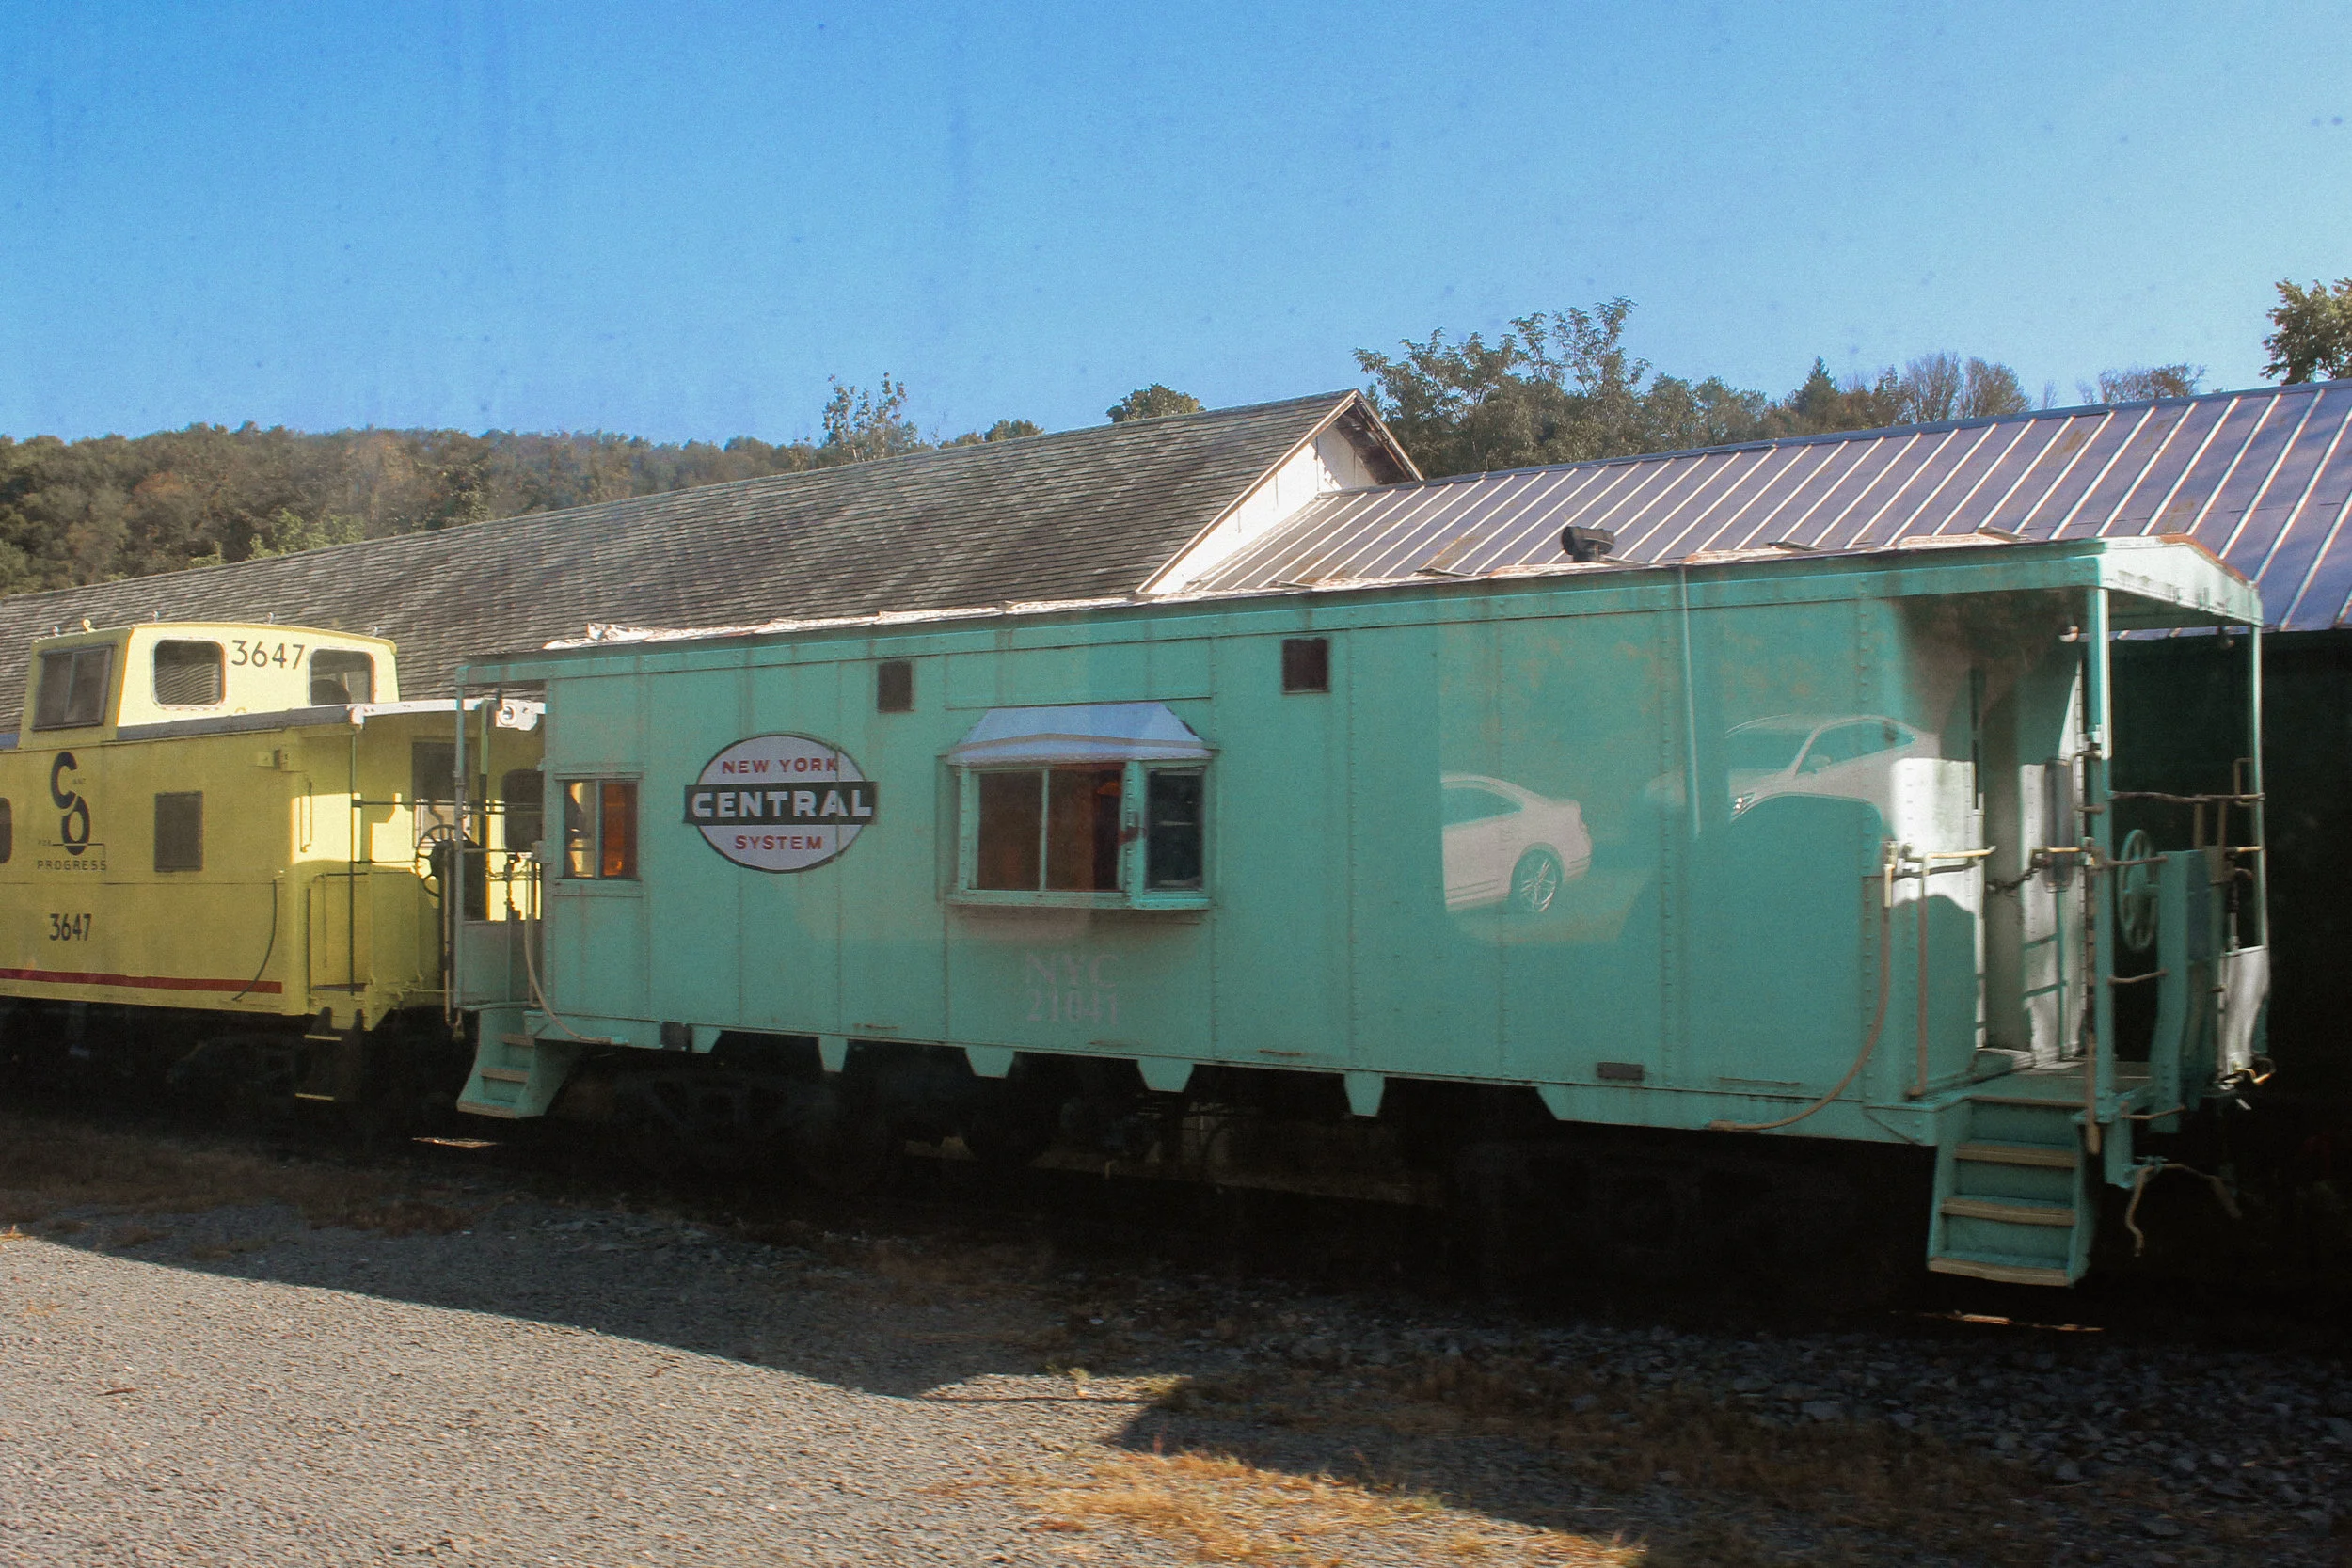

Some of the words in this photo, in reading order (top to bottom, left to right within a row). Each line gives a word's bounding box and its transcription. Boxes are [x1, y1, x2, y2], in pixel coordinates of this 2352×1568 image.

[231, 640, 305, 669] 3647
[722, 760, 770, 774] NEW
[779, 758, 838, 773] YORK
[691, 789, 873, 818] CENTRAL
[735, 835, 823, 850] SYSTEM
[37, 860, 107, 871] PROGRESS
[49, 913, 92, 941] 3647
[1025, 952, 1120, 989] NYC
